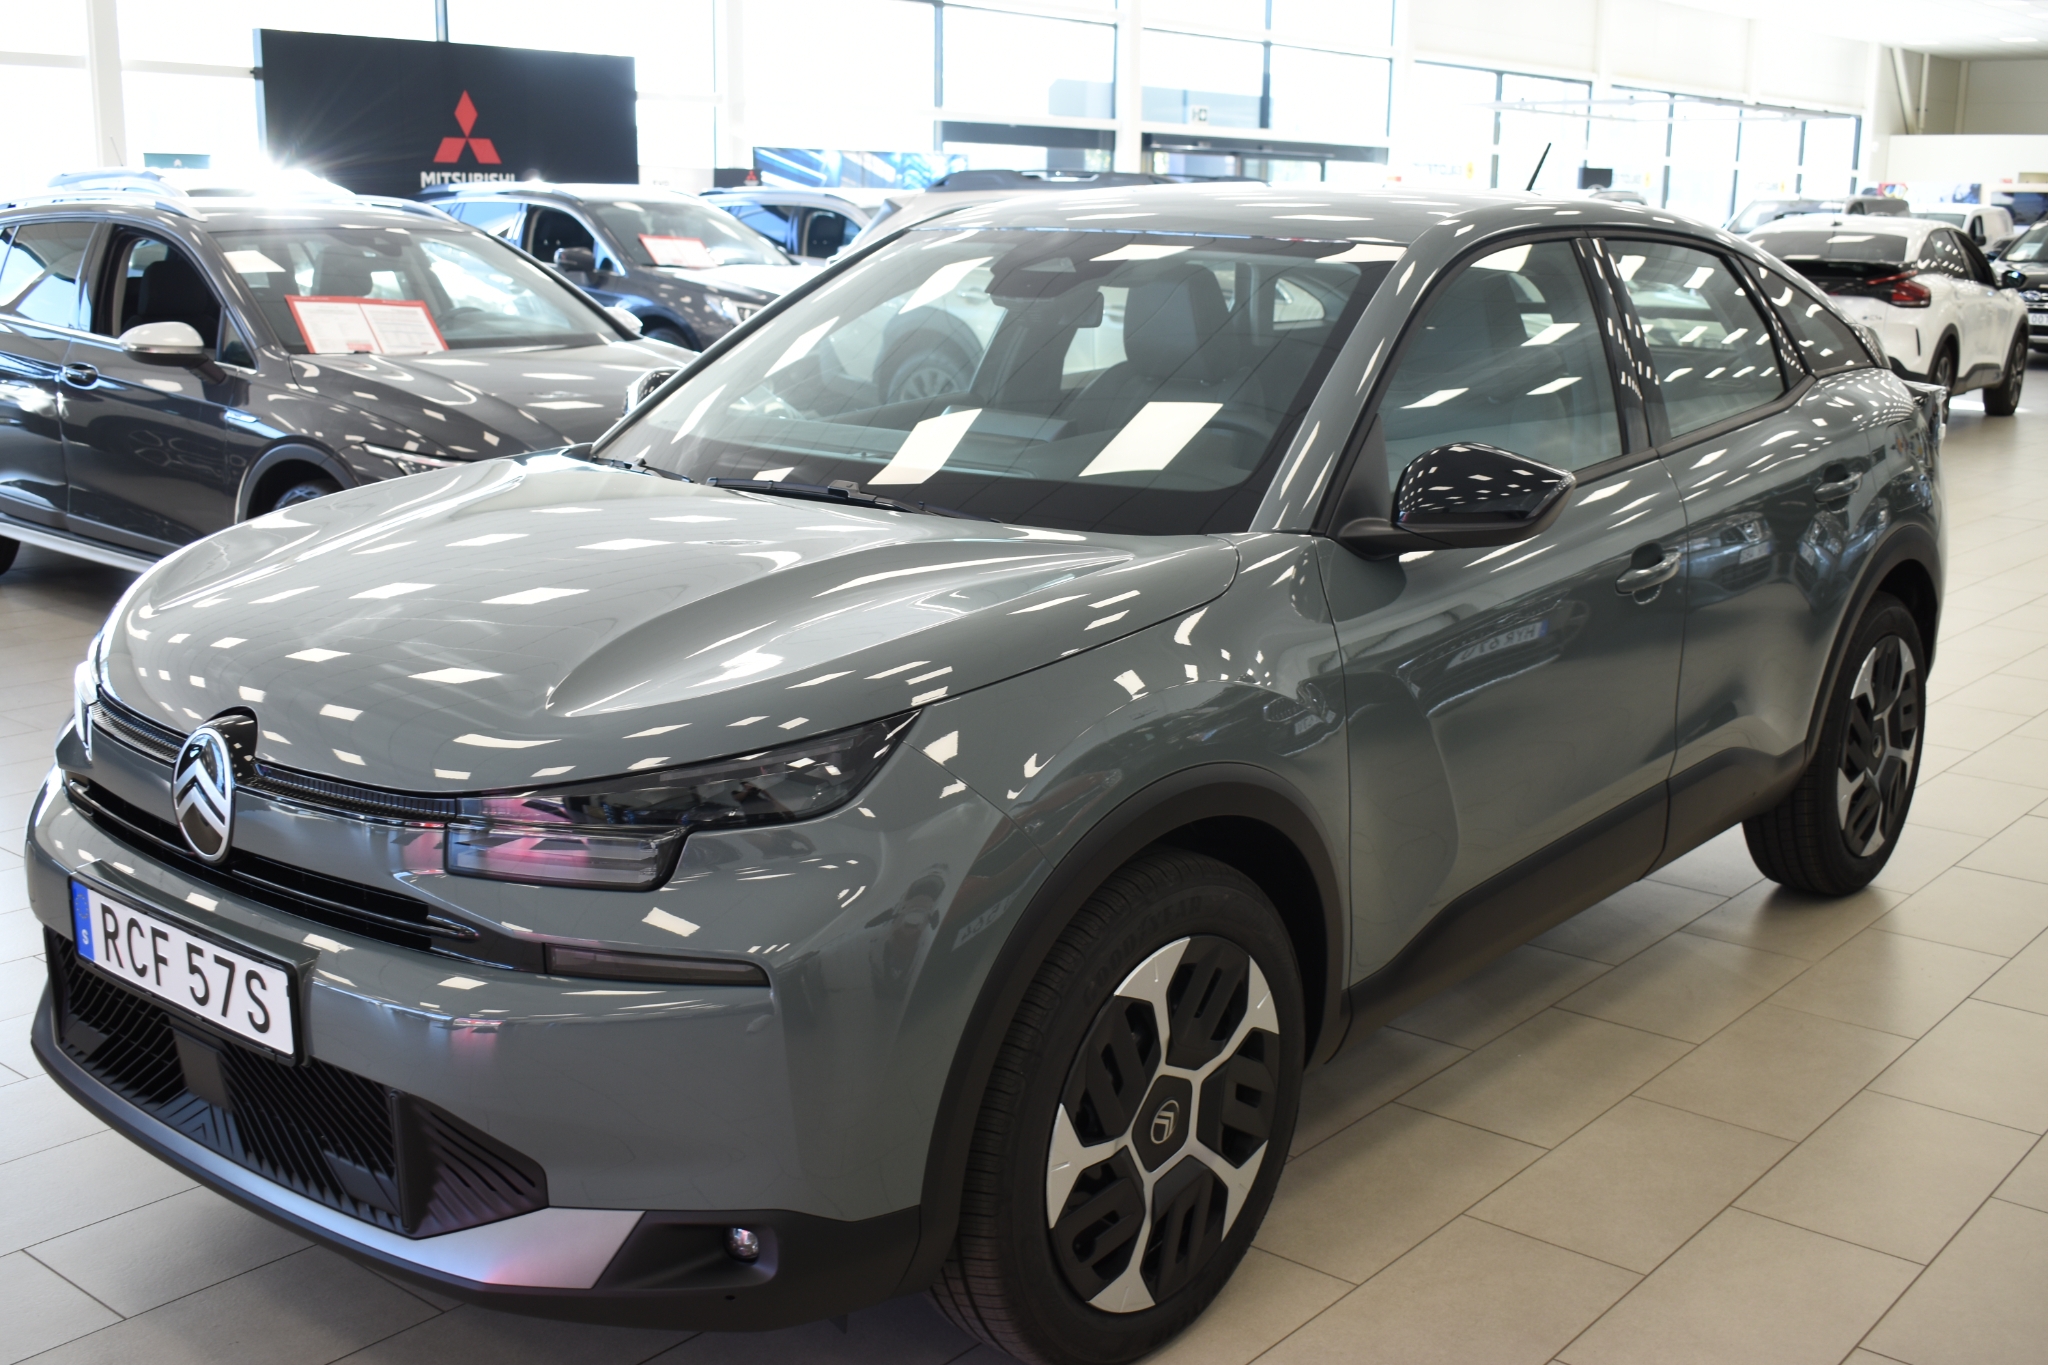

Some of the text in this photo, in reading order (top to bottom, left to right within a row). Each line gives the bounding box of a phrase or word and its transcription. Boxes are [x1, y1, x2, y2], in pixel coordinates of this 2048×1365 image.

[81, 902, 271, 1034] S RCF 57S
